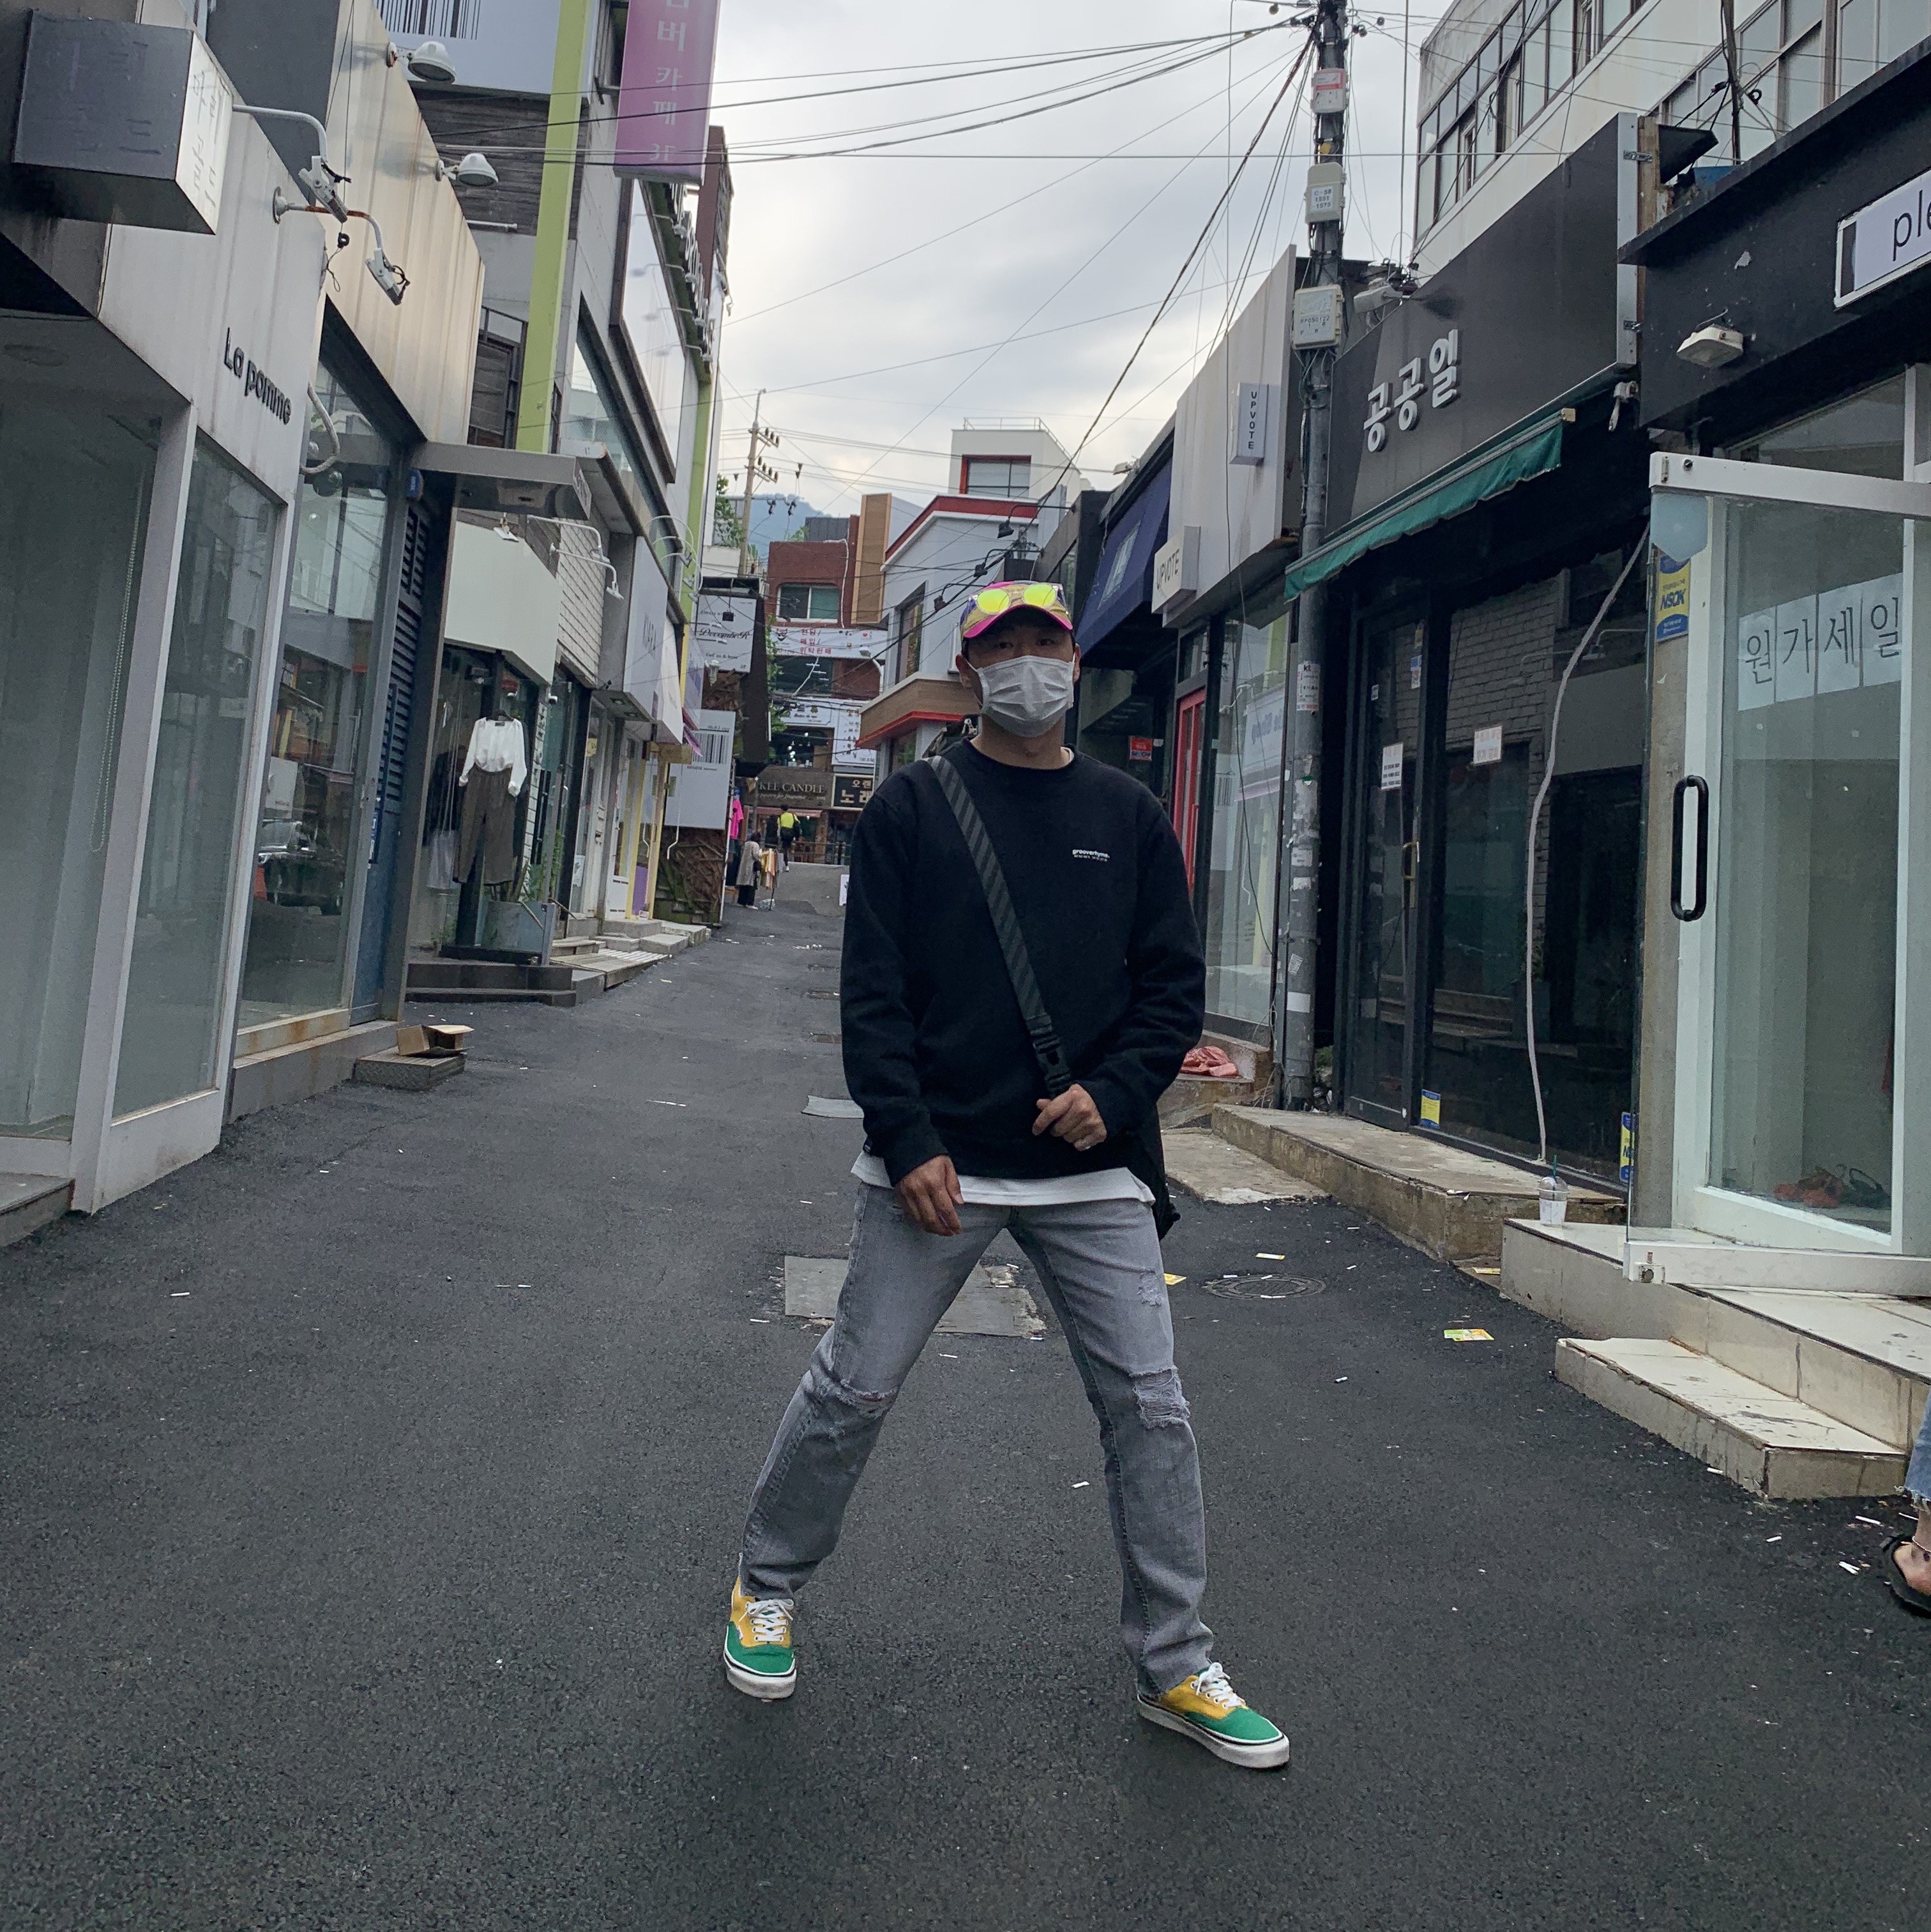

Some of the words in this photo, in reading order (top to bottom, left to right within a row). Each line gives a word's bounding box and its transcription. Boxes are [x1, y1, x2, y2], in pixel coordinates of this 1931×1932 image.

[1893, 189, 1931, 262] pl
[223, 326, 245, 379] La
[244, 360, 292, 425] pomme
[1363, 328, 1459, 453] 공공일
[1248, 391, 1258, 450] UPVOTE
[1156, 548, 1180, 591] UPVOTE
[1745, 597, 1900, 685] 원가세일
[782, 783, 826, 794] CANDLE
